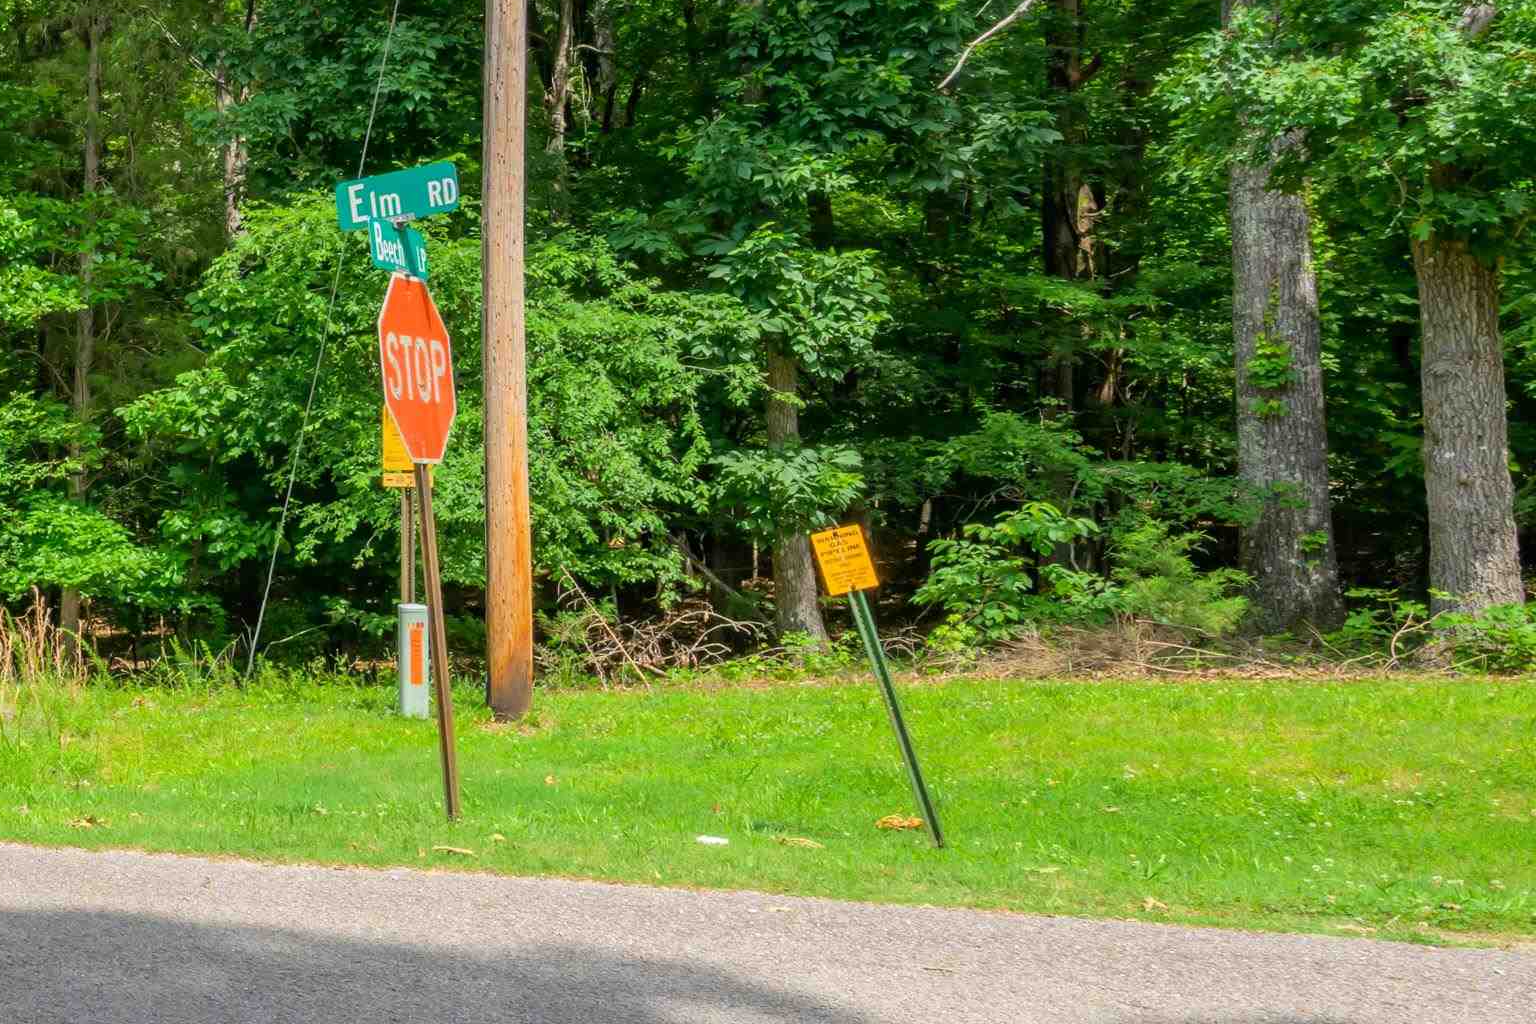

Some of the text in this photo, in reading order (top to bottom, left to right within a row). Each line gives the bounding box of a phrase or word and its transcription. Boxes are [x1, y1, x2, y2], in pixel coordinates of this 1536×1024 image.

[348, 177, 458, 223] Elm RD
[386, 331, 446, 404] STOP
